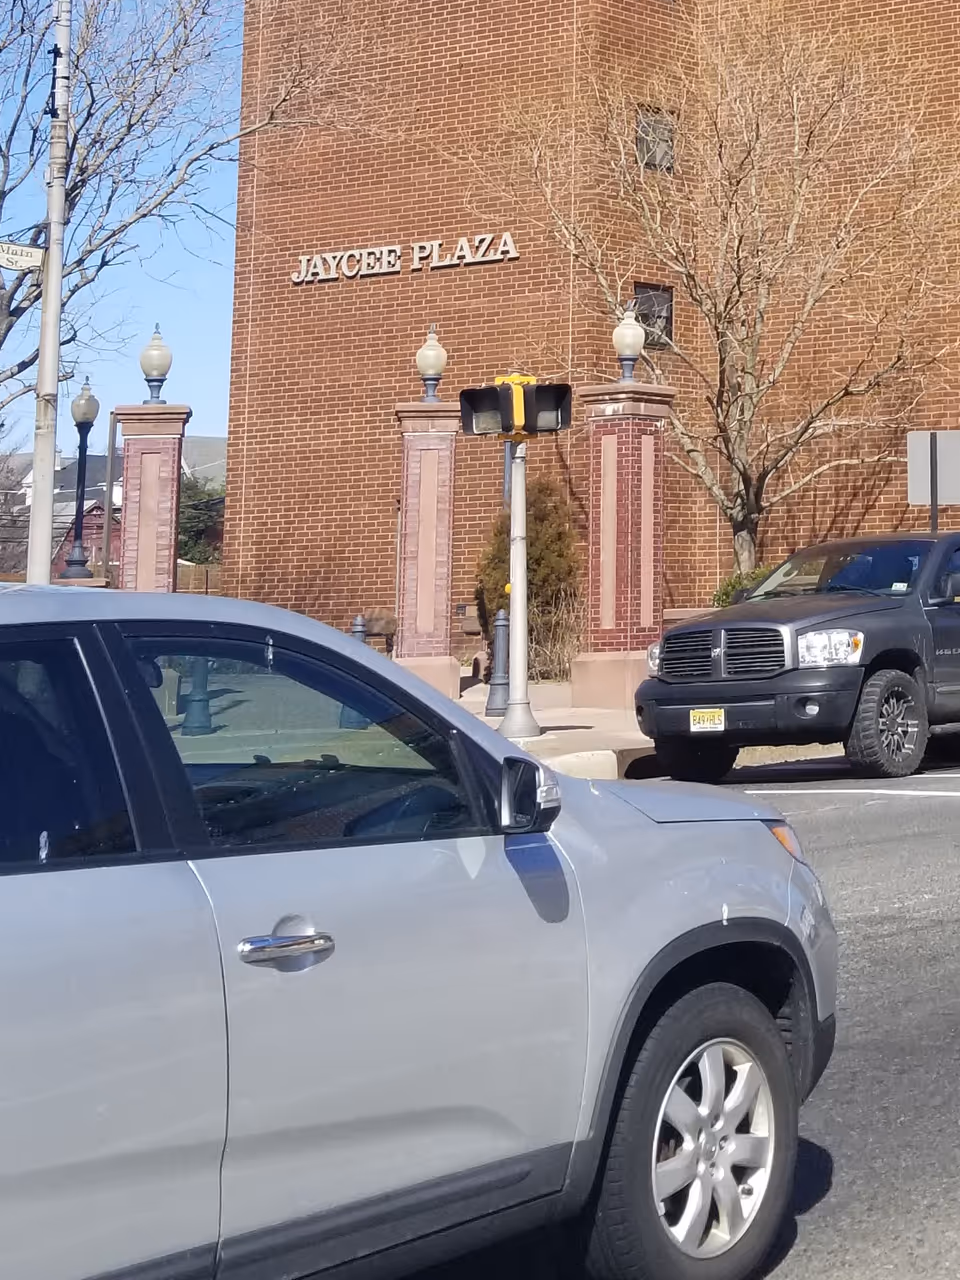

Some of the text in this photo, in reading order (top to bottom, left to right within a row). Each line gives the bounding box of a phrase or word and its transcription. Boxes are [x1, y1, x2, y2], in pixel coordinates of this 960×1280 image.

[0, 244, 33, 258] Main
[291, 231, 520, 284] JAYCEE PLAZA
